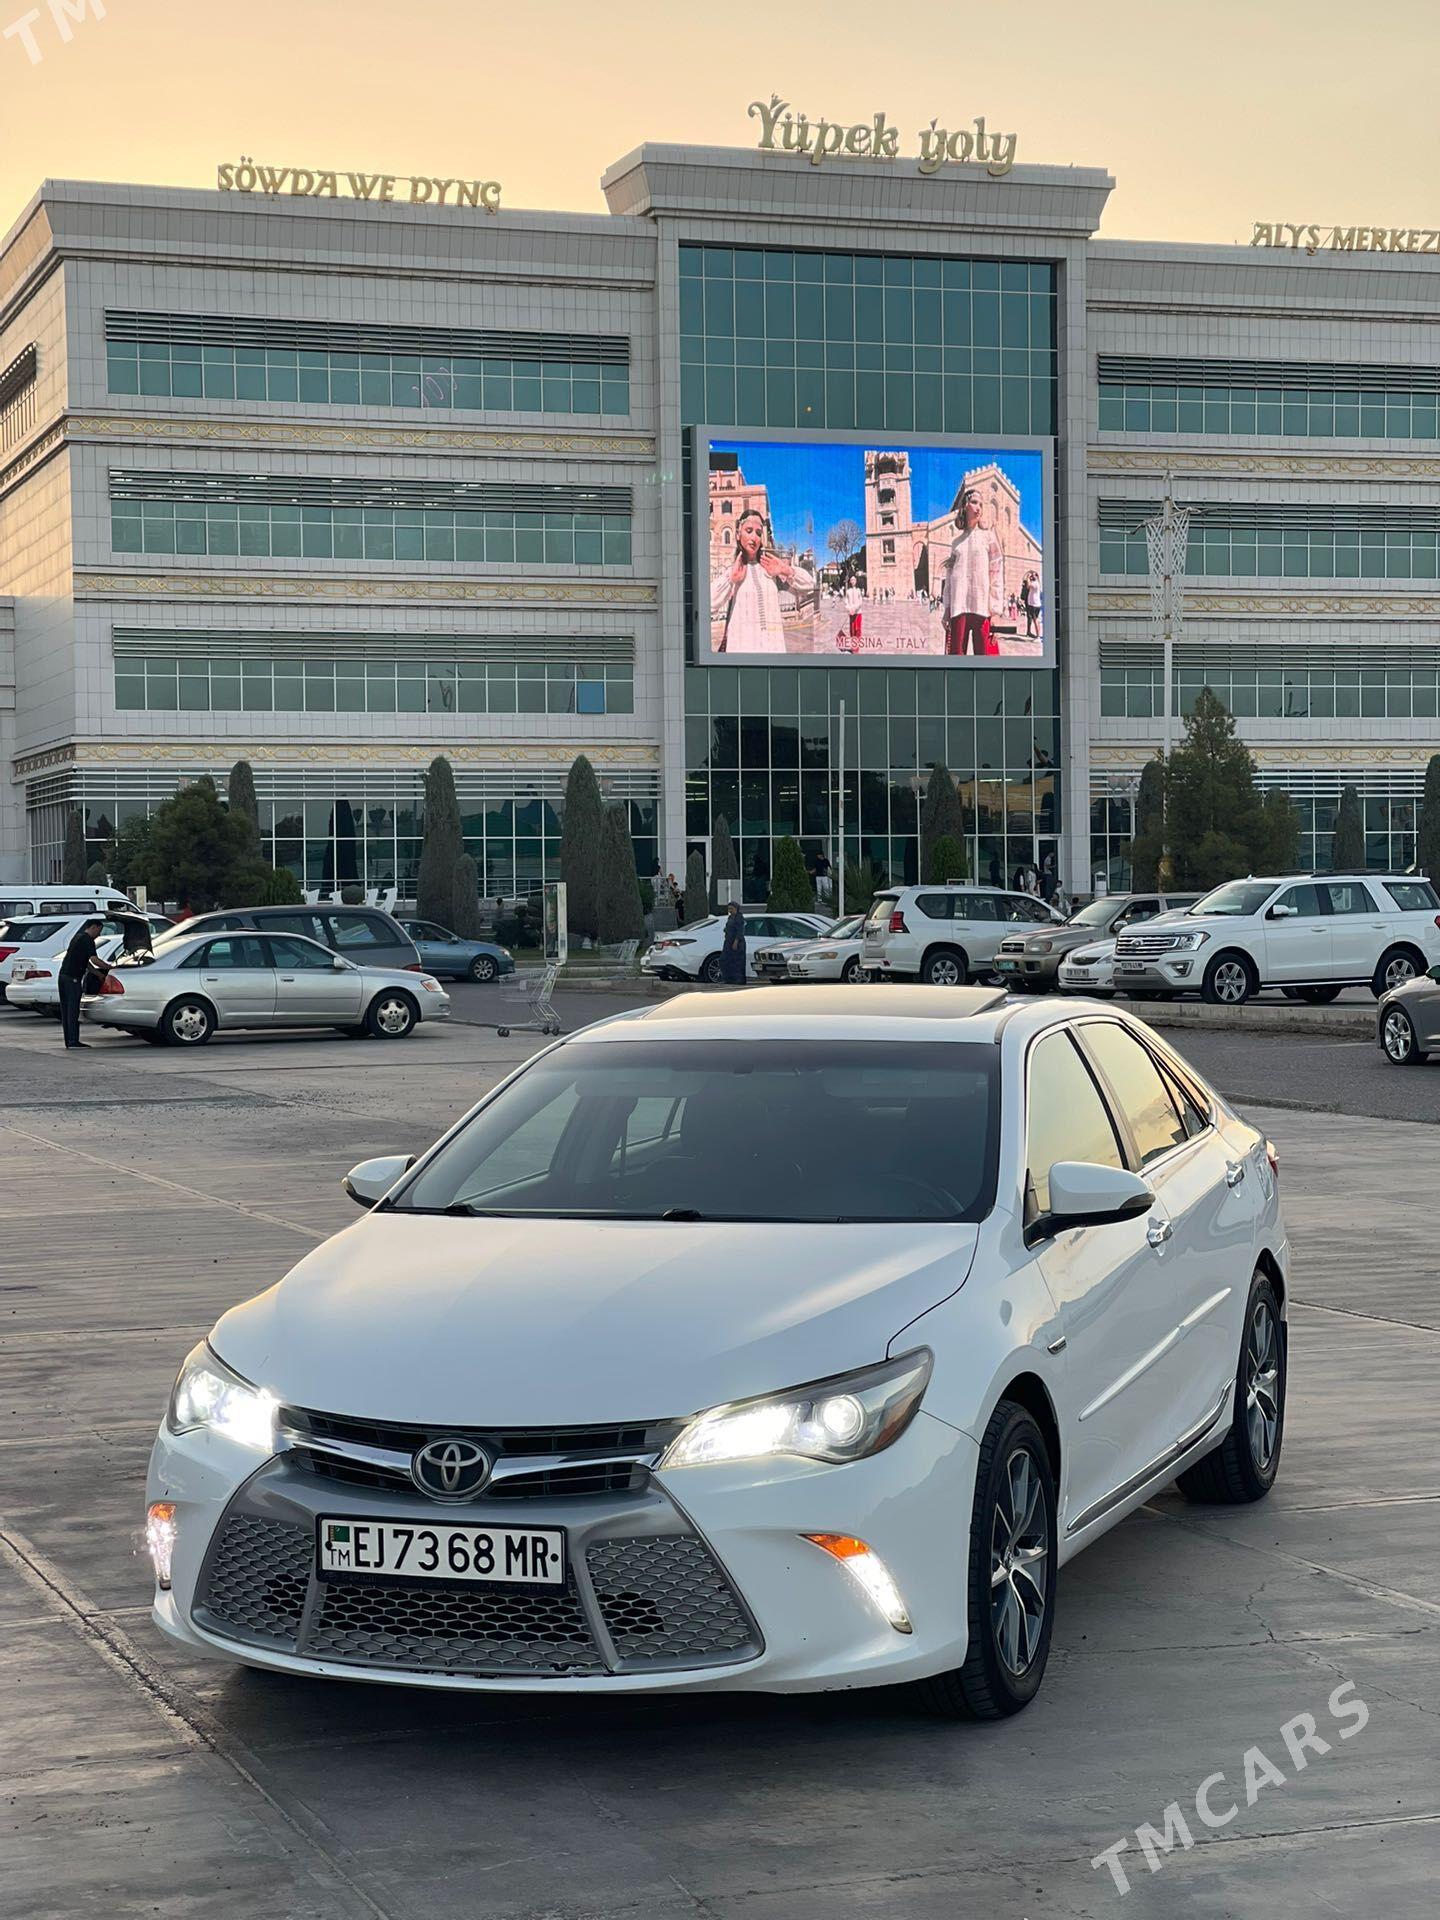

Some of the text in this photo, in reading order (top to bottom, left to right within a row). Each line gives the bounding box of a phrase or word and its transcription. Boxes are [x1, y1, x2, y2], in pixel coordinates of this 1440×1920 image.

[218, 156, 337, 198] SÖWDA
[347, 172, 396, 201] WE
[1251, 222, 1320, 256] ALYŞ
[836, 636, 883, 648] MESSINA
[896, 637, 928, 649] ITALY
[328, 1548, 350, 1566] TM
